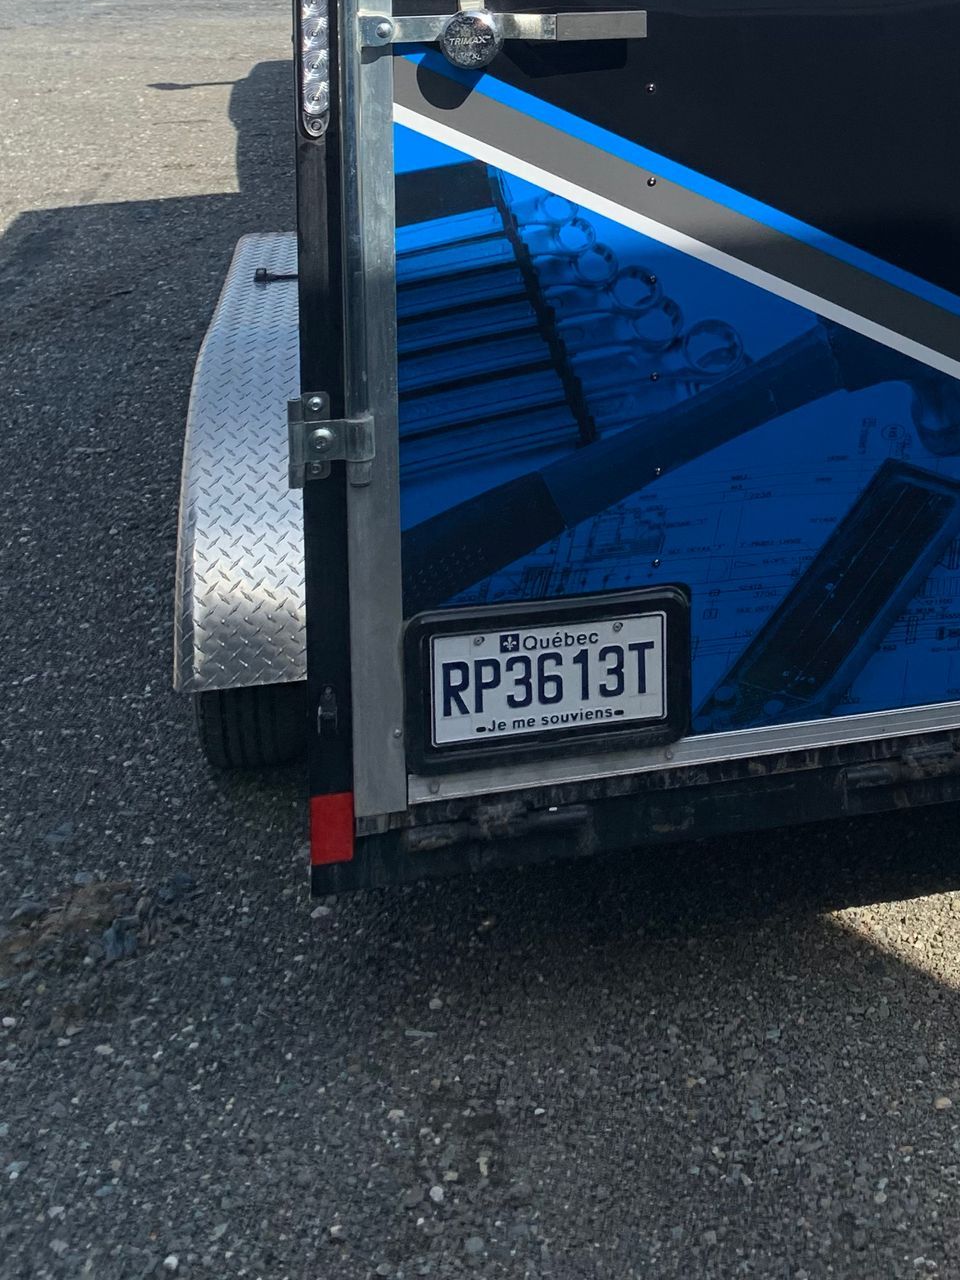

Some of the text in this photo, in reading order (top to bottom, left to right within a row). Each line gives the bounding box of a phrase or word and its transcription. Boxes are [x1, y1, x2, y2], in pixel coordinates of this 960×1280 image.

[522, 631, 599, 651] Québec
[441, 640, 655, 717] RP3613T
[487, 707, 613, 733] Je me souviens
